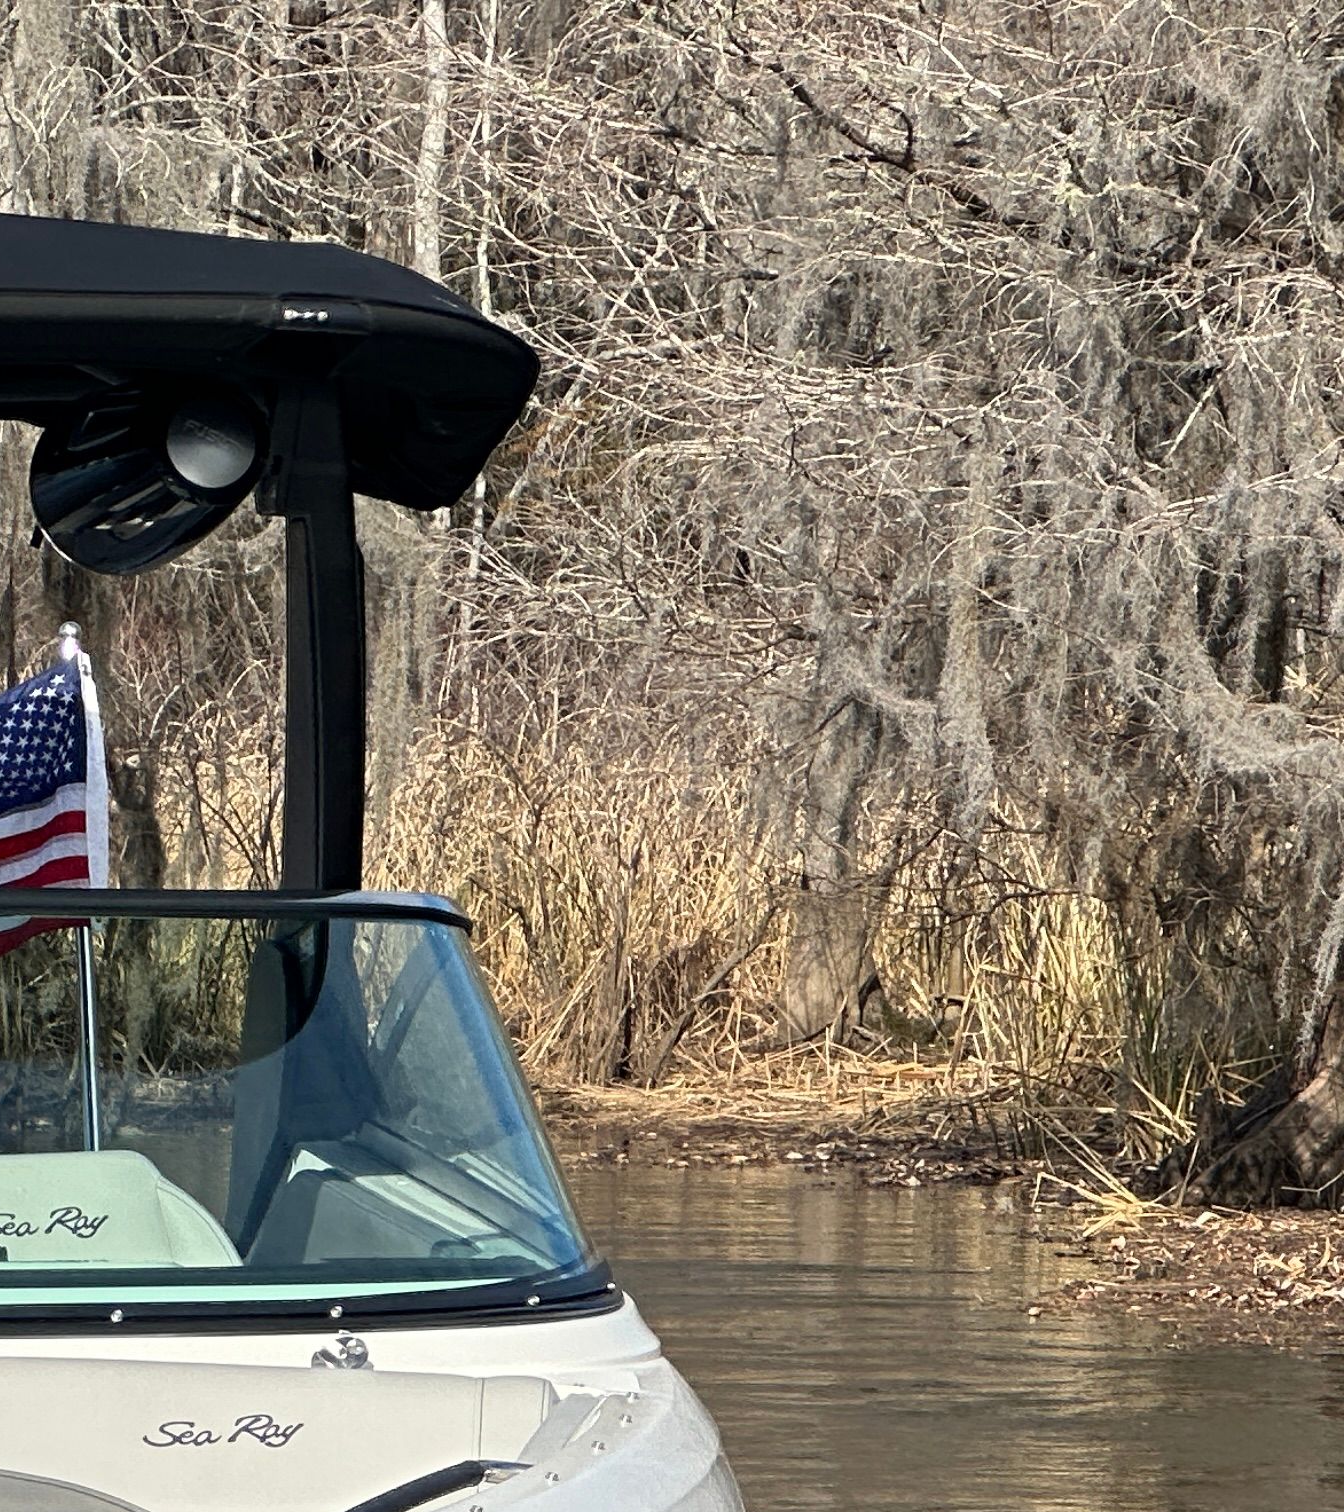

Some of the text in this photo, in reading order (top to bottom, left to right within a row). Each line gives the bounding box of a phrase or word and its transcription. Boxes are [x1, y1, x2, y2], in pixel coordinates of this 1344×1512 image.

[44, 1206, 109, 1239] Ray
[142, 1413, 305, 1449] Sea Ray
